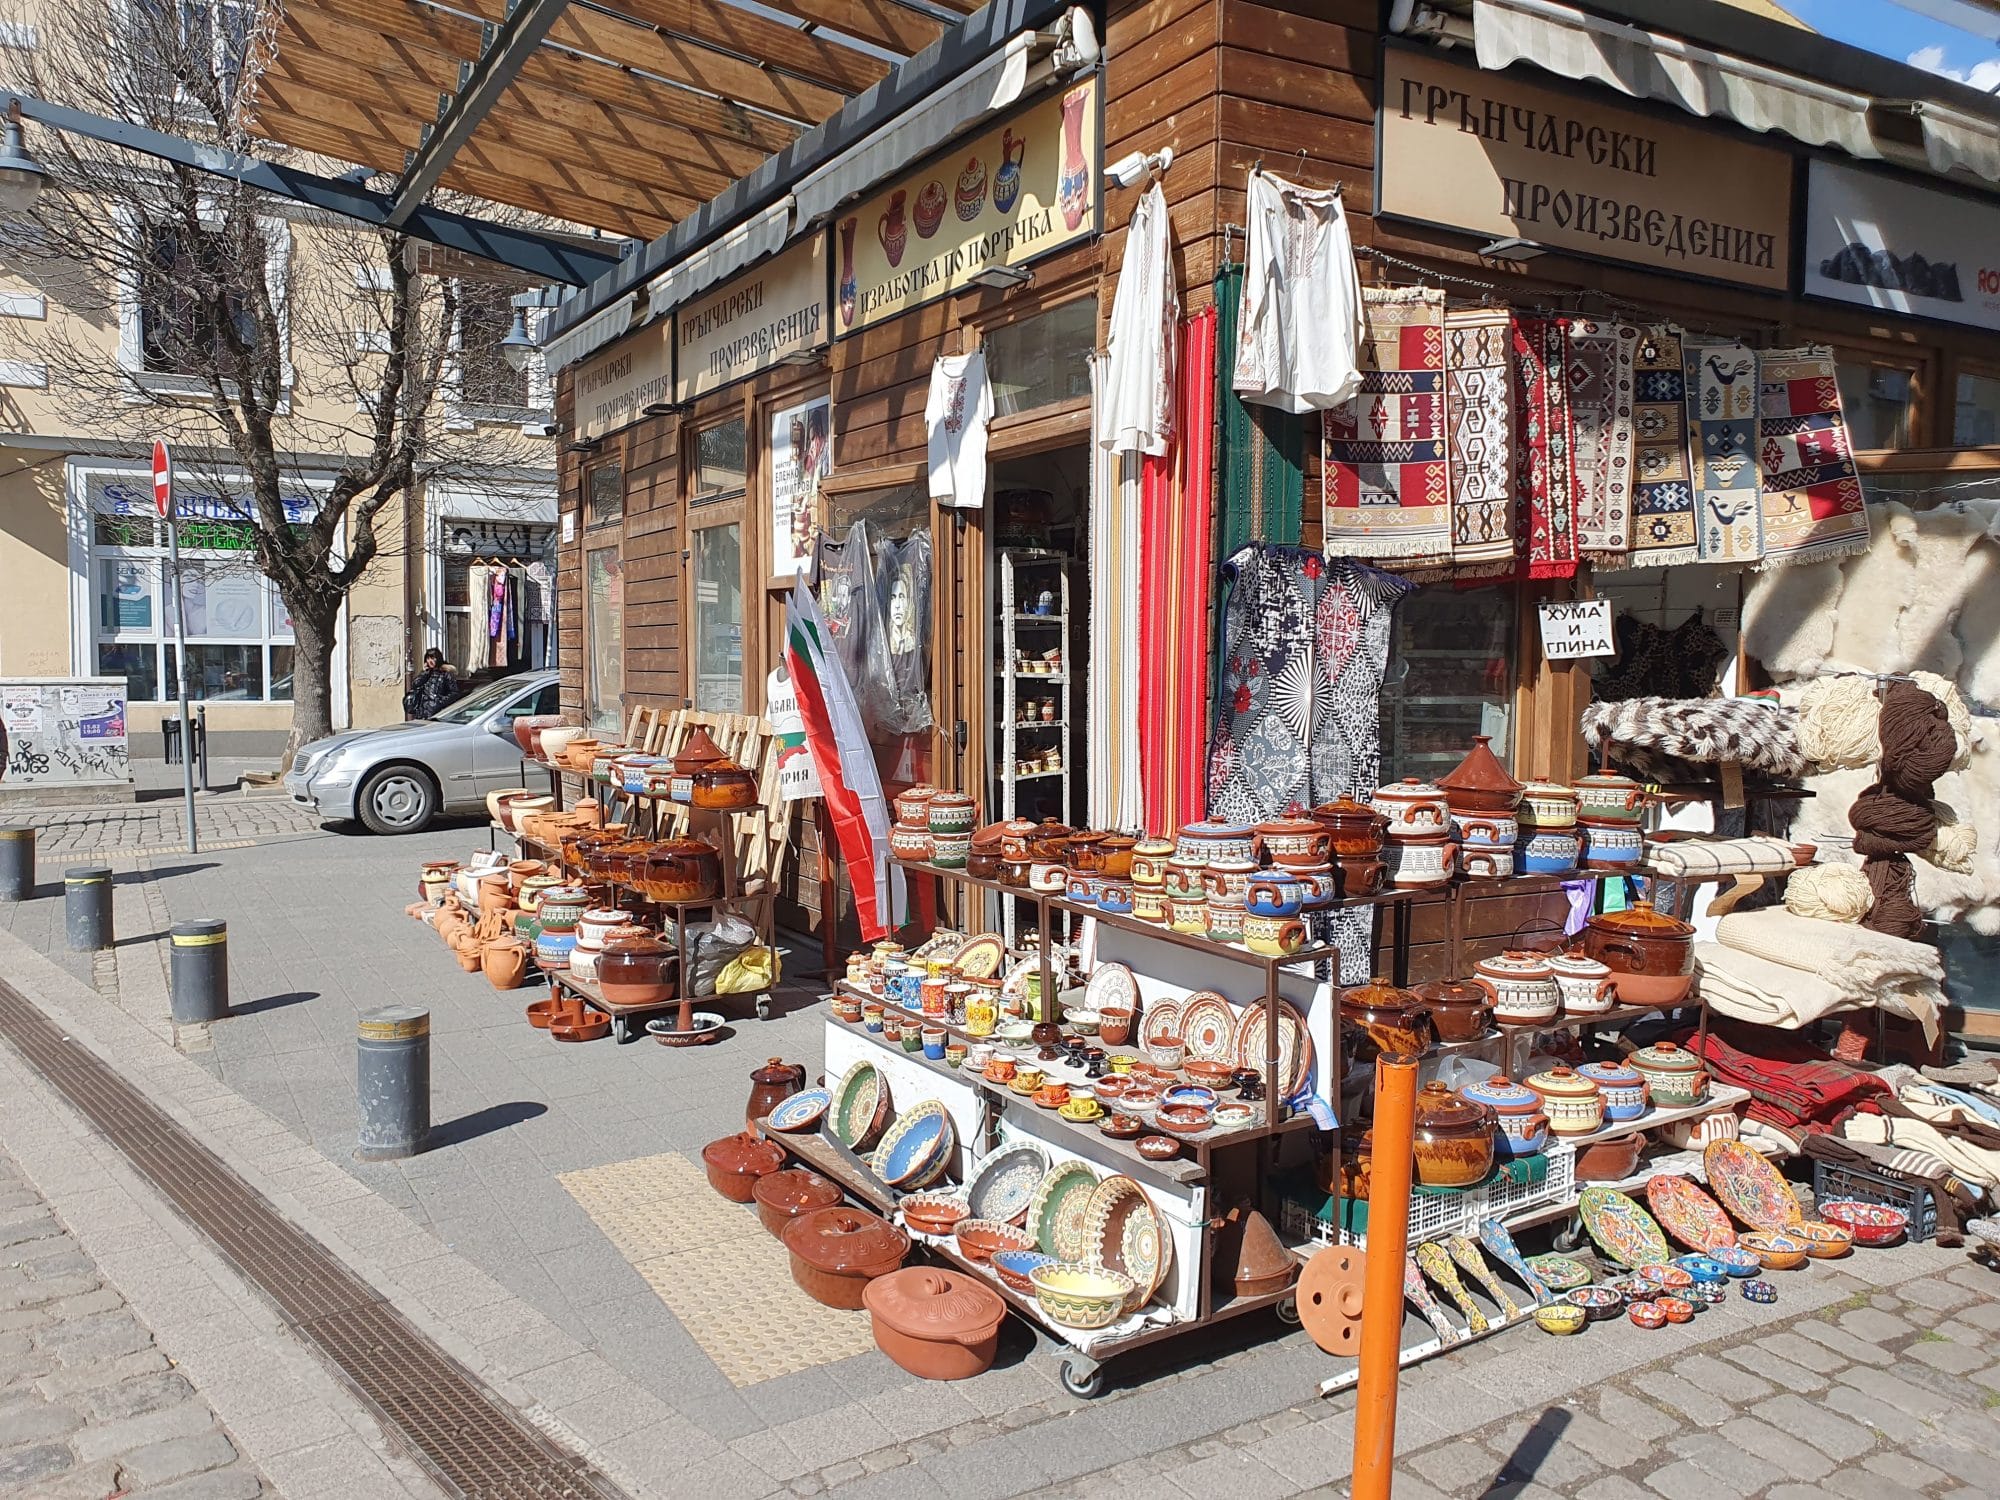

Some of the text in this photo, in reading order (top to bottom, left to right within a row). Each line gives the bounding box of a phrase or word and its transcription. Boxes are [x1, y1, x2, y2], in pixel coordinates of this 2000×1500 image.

[1399, 77, 1658, 178] ГРЪНЧАРСКИ
[1501, 175, 1776, 270] ПРОИЗВЕДЕНИЯ
[860, 208, 1053, 315] ИЗРАБОТКА ПО ПОРЪЧКА
[681, 280, 764, 347] ГРЪНЧАРСКИ
[709, 302, 820, 376] ПРОИЗВЕДЕНИЯ
[577, 351, 632, 400] ГРЪНЧАРСКИ
[596, 374, 668, 426] ПРОИЗВЕДЕНИЯ
[775, 467, 799, 482] ЕЛЕНКО
[775, 480, 810, 498] ДИМИТРОВ
[1547, 606, 1602, 621] ХУМА
[1568, 624, 1580, 636] И
[1546, 639, 1610, 653] ГЛИНА
